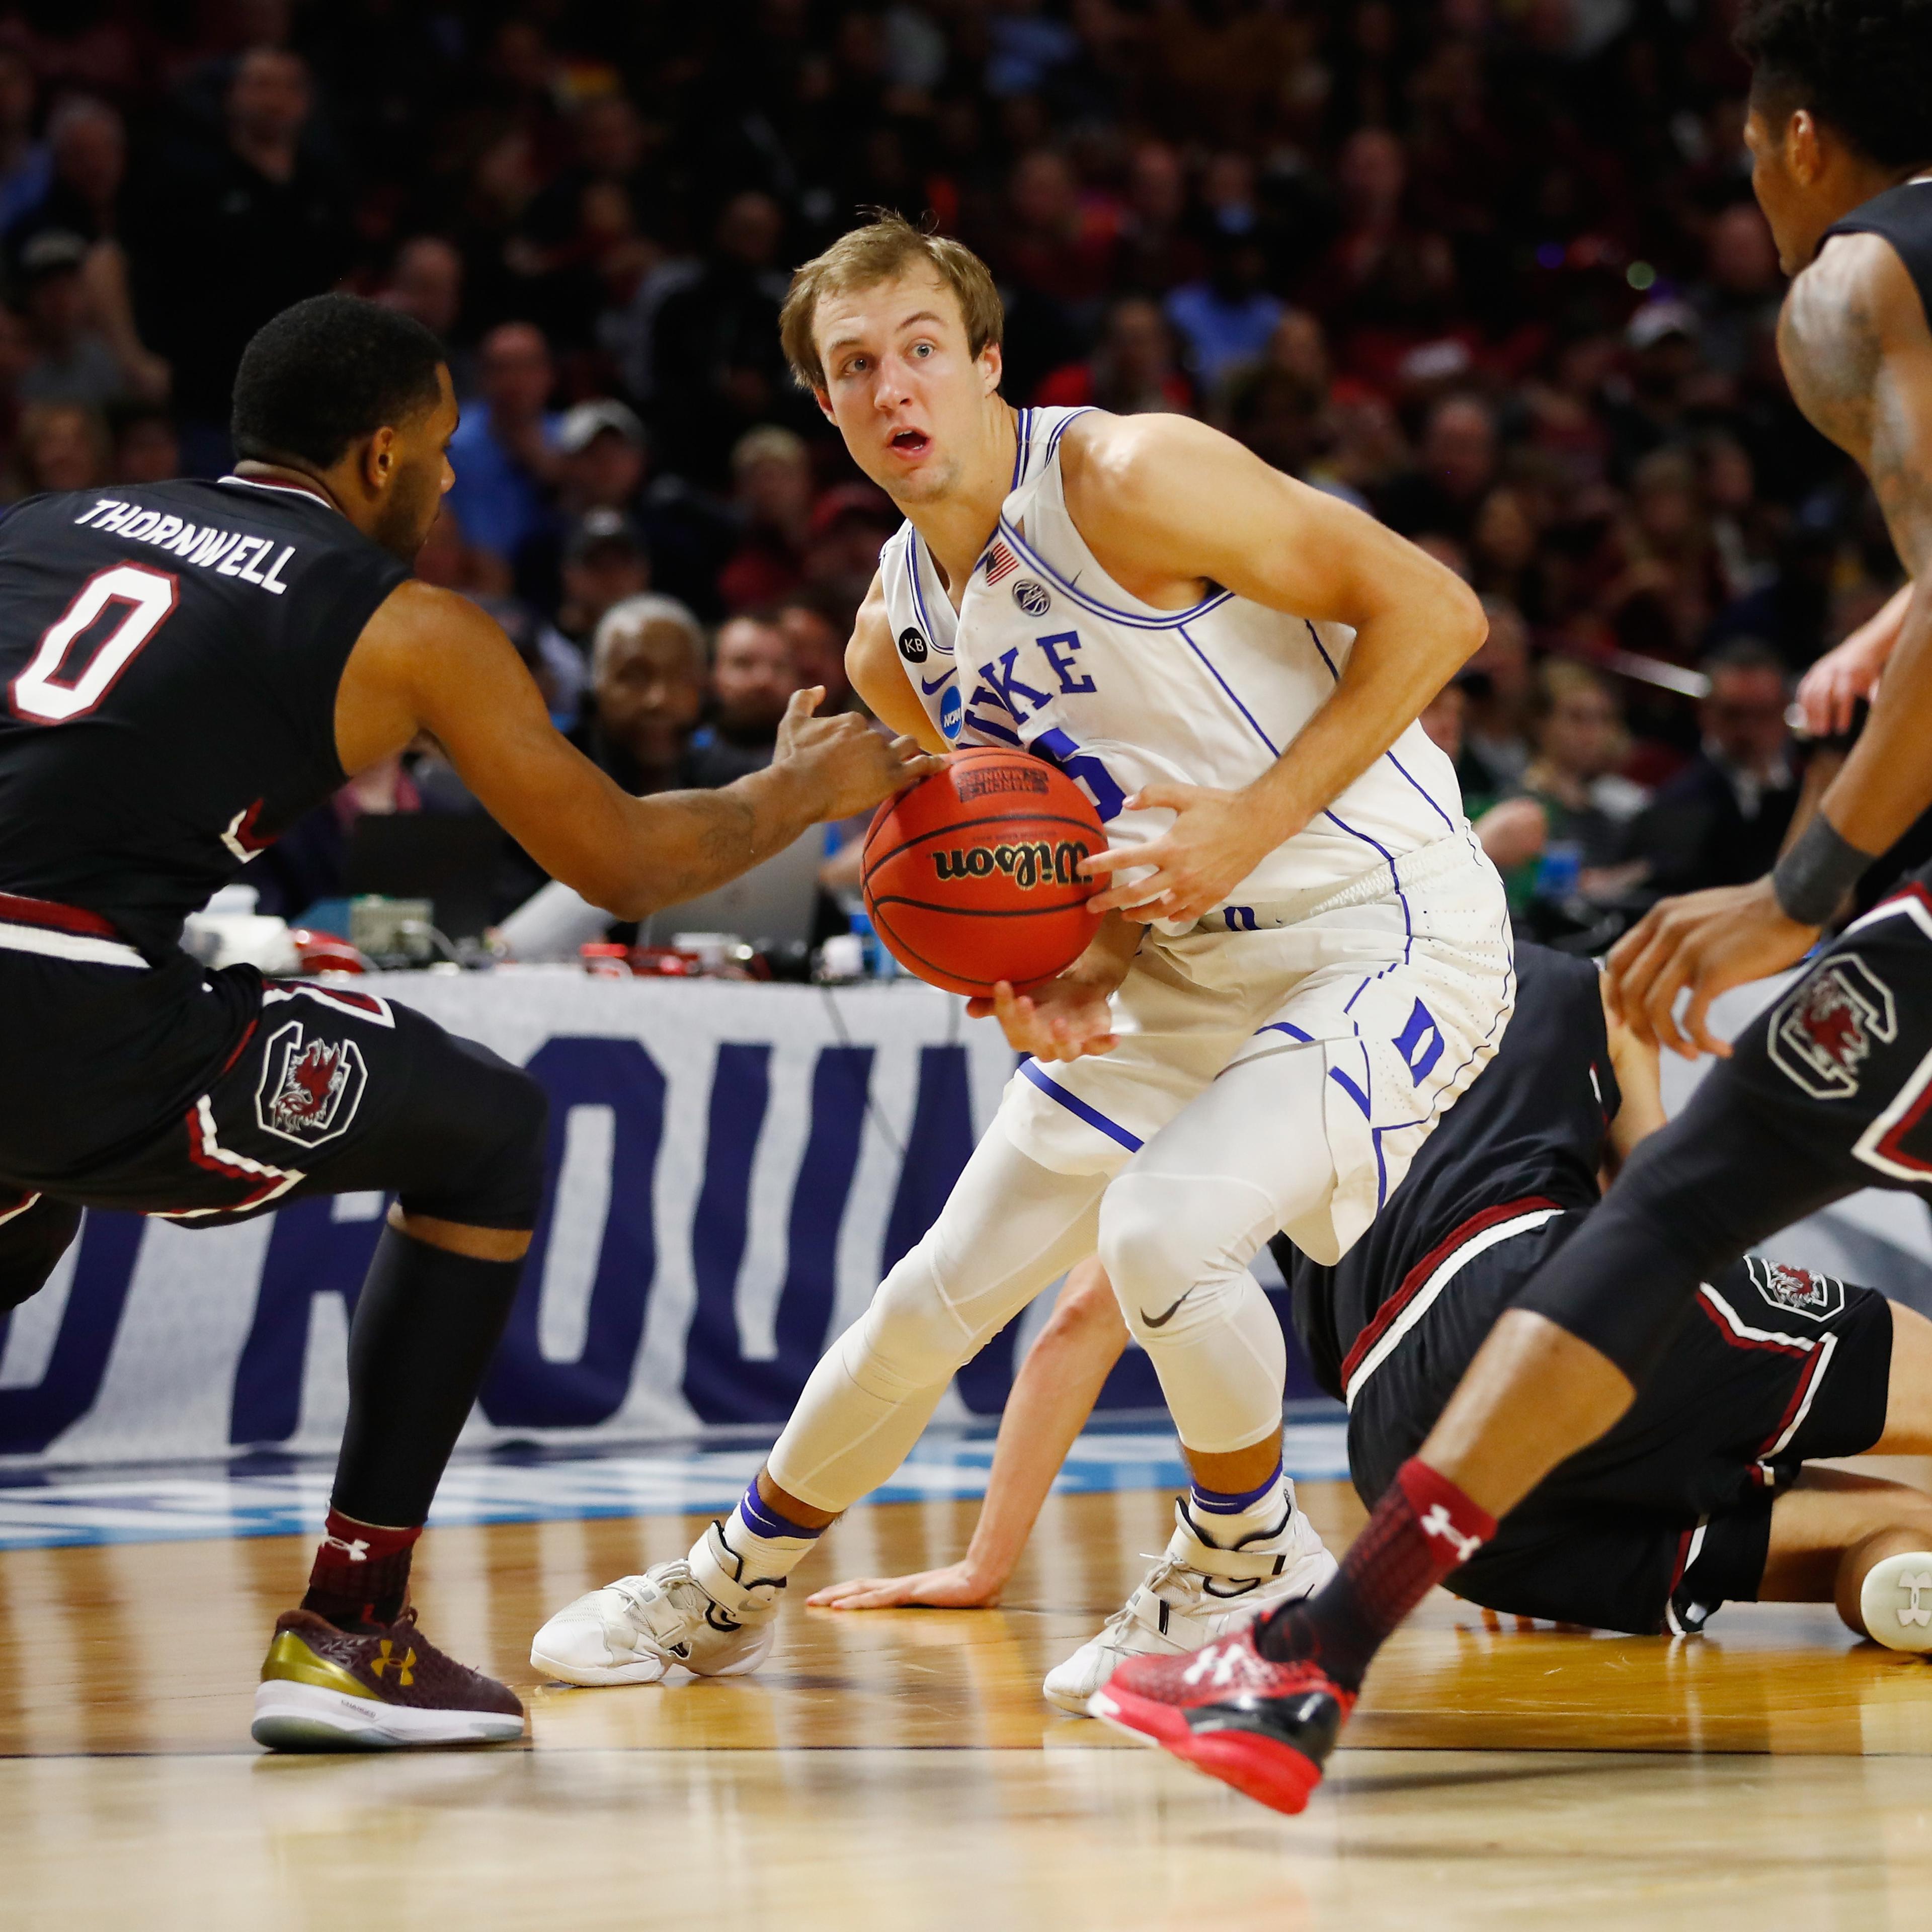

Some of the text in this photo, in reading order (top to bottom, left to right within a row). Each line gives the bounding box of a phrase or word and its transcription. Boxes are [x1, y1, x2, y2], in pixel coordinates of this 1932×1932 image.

[75, 499, 296, 595] THORNWELL
[7, 559, 180, 726] 0
[904, 638, 924, 654] KB
[932, 840, 1094, 891] Wilson
